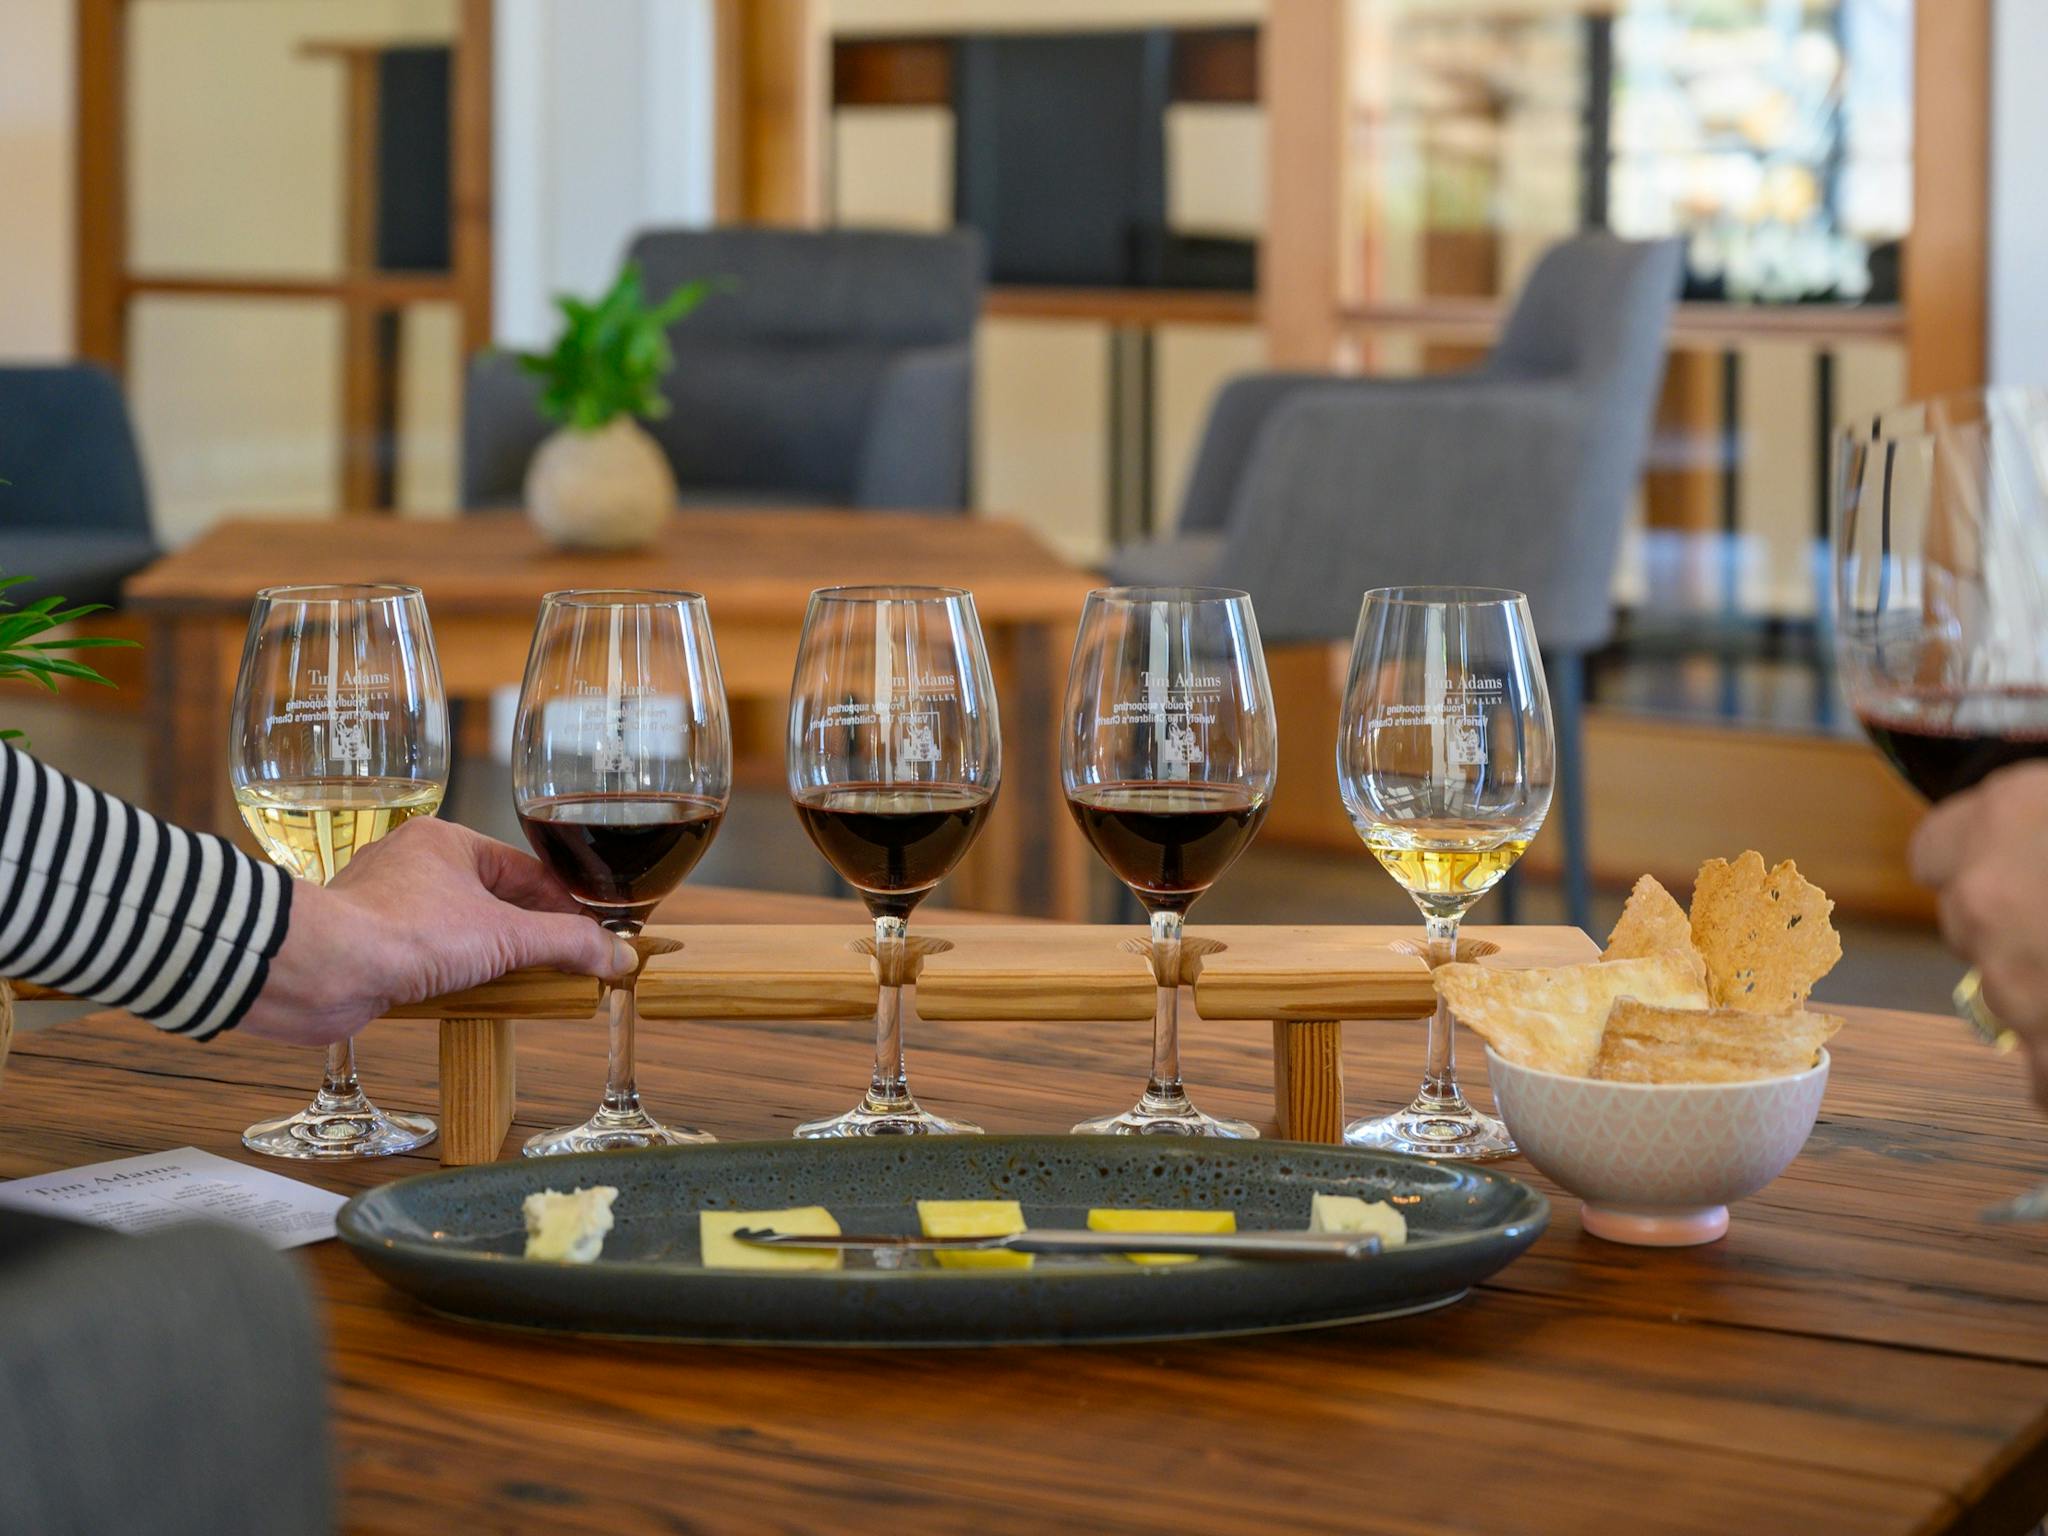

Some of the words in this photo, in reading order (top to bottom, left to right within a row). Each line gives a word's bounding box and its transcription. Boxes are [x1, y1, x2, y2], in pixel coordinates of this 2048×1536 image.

[342, 670, 390, 685] Adams
[1174, 672, 1222, 688] Adams
[1458, 673, 1503, 689] Adams
[609, 679, 657, 696] dams
[93, 1164, 181, 1185] Adams
